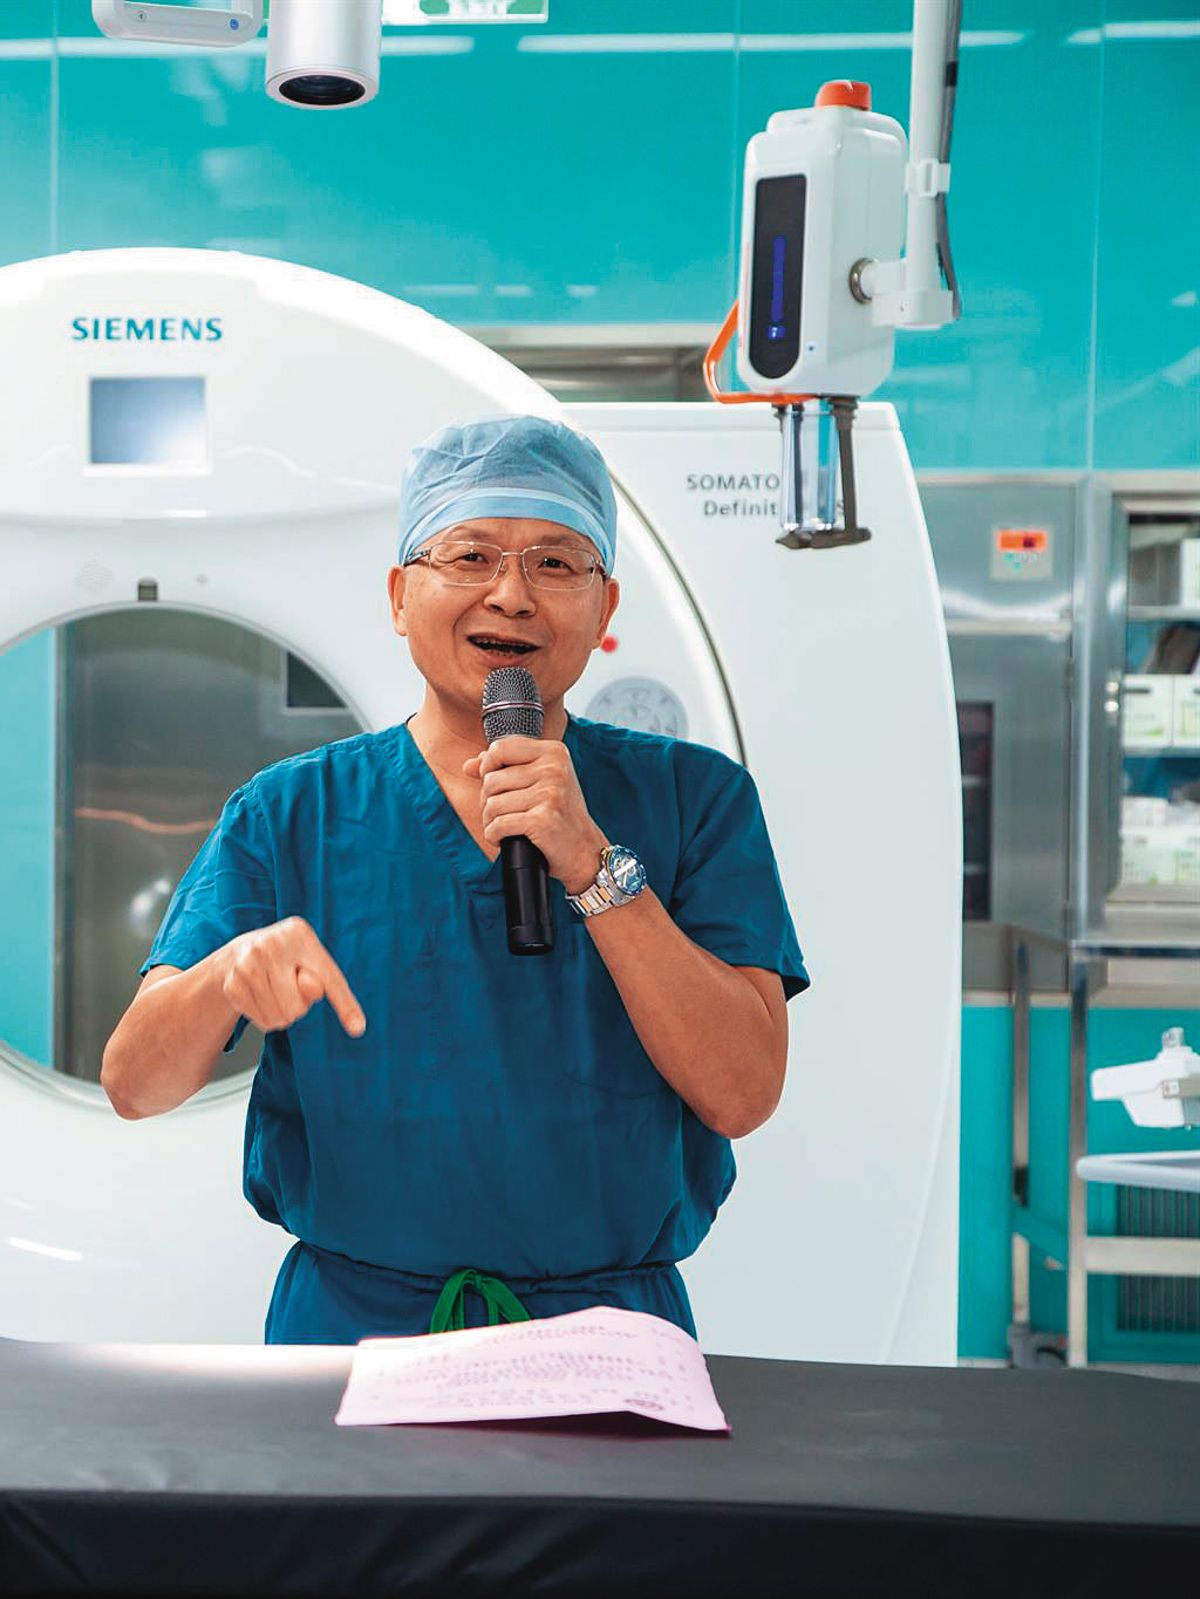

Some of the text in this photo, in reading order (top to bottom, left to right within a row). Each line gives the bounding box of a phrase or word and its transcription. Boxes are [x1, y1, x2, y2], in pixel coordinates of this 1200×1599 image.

[71, 317, 223, 342] SIEMENS
[687, 473, 781, 490] SOMATO
[703, 499, 778, 516] Definit
